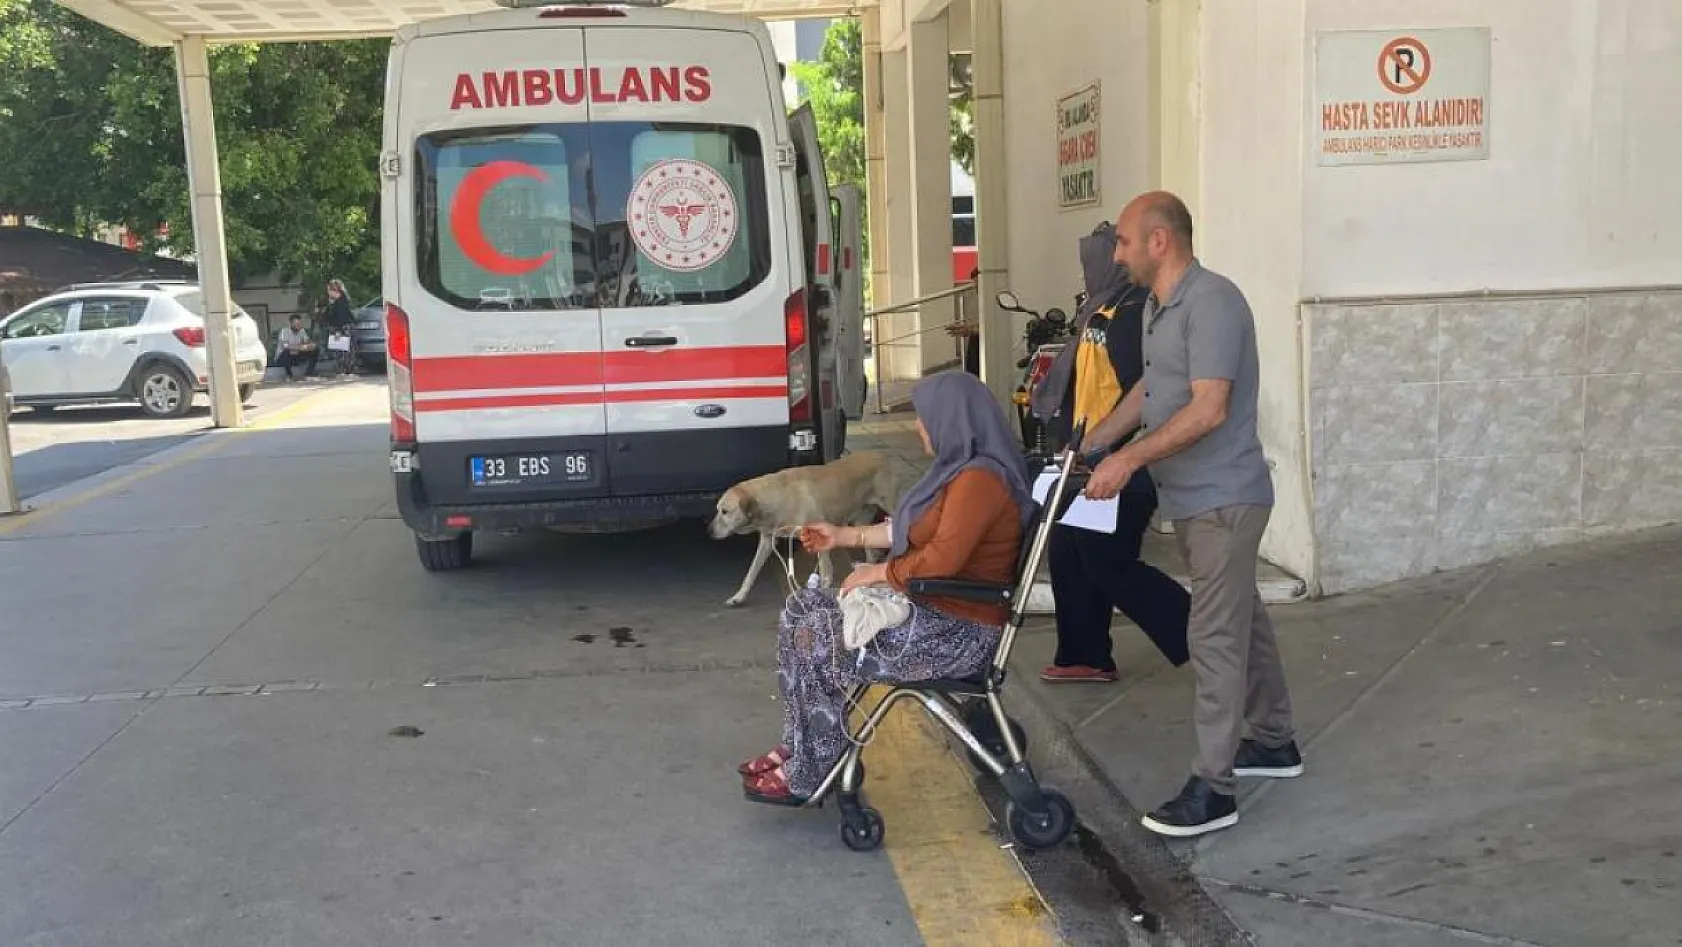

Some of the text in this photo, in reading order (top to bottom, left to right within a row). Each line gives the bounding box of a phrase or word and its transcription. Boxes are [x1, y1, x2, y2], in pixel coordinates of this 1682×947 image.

[451, 66, 711, 109] AMBULANS
[1322, 97, 1484, 131] HASTA SEVK ALANIDIR!
[1322, 137, 1361, 153] AMBULANS
[1389, 135, 1406, 151] PARK
[485, 456, 587, 477] 33 EBS 96
